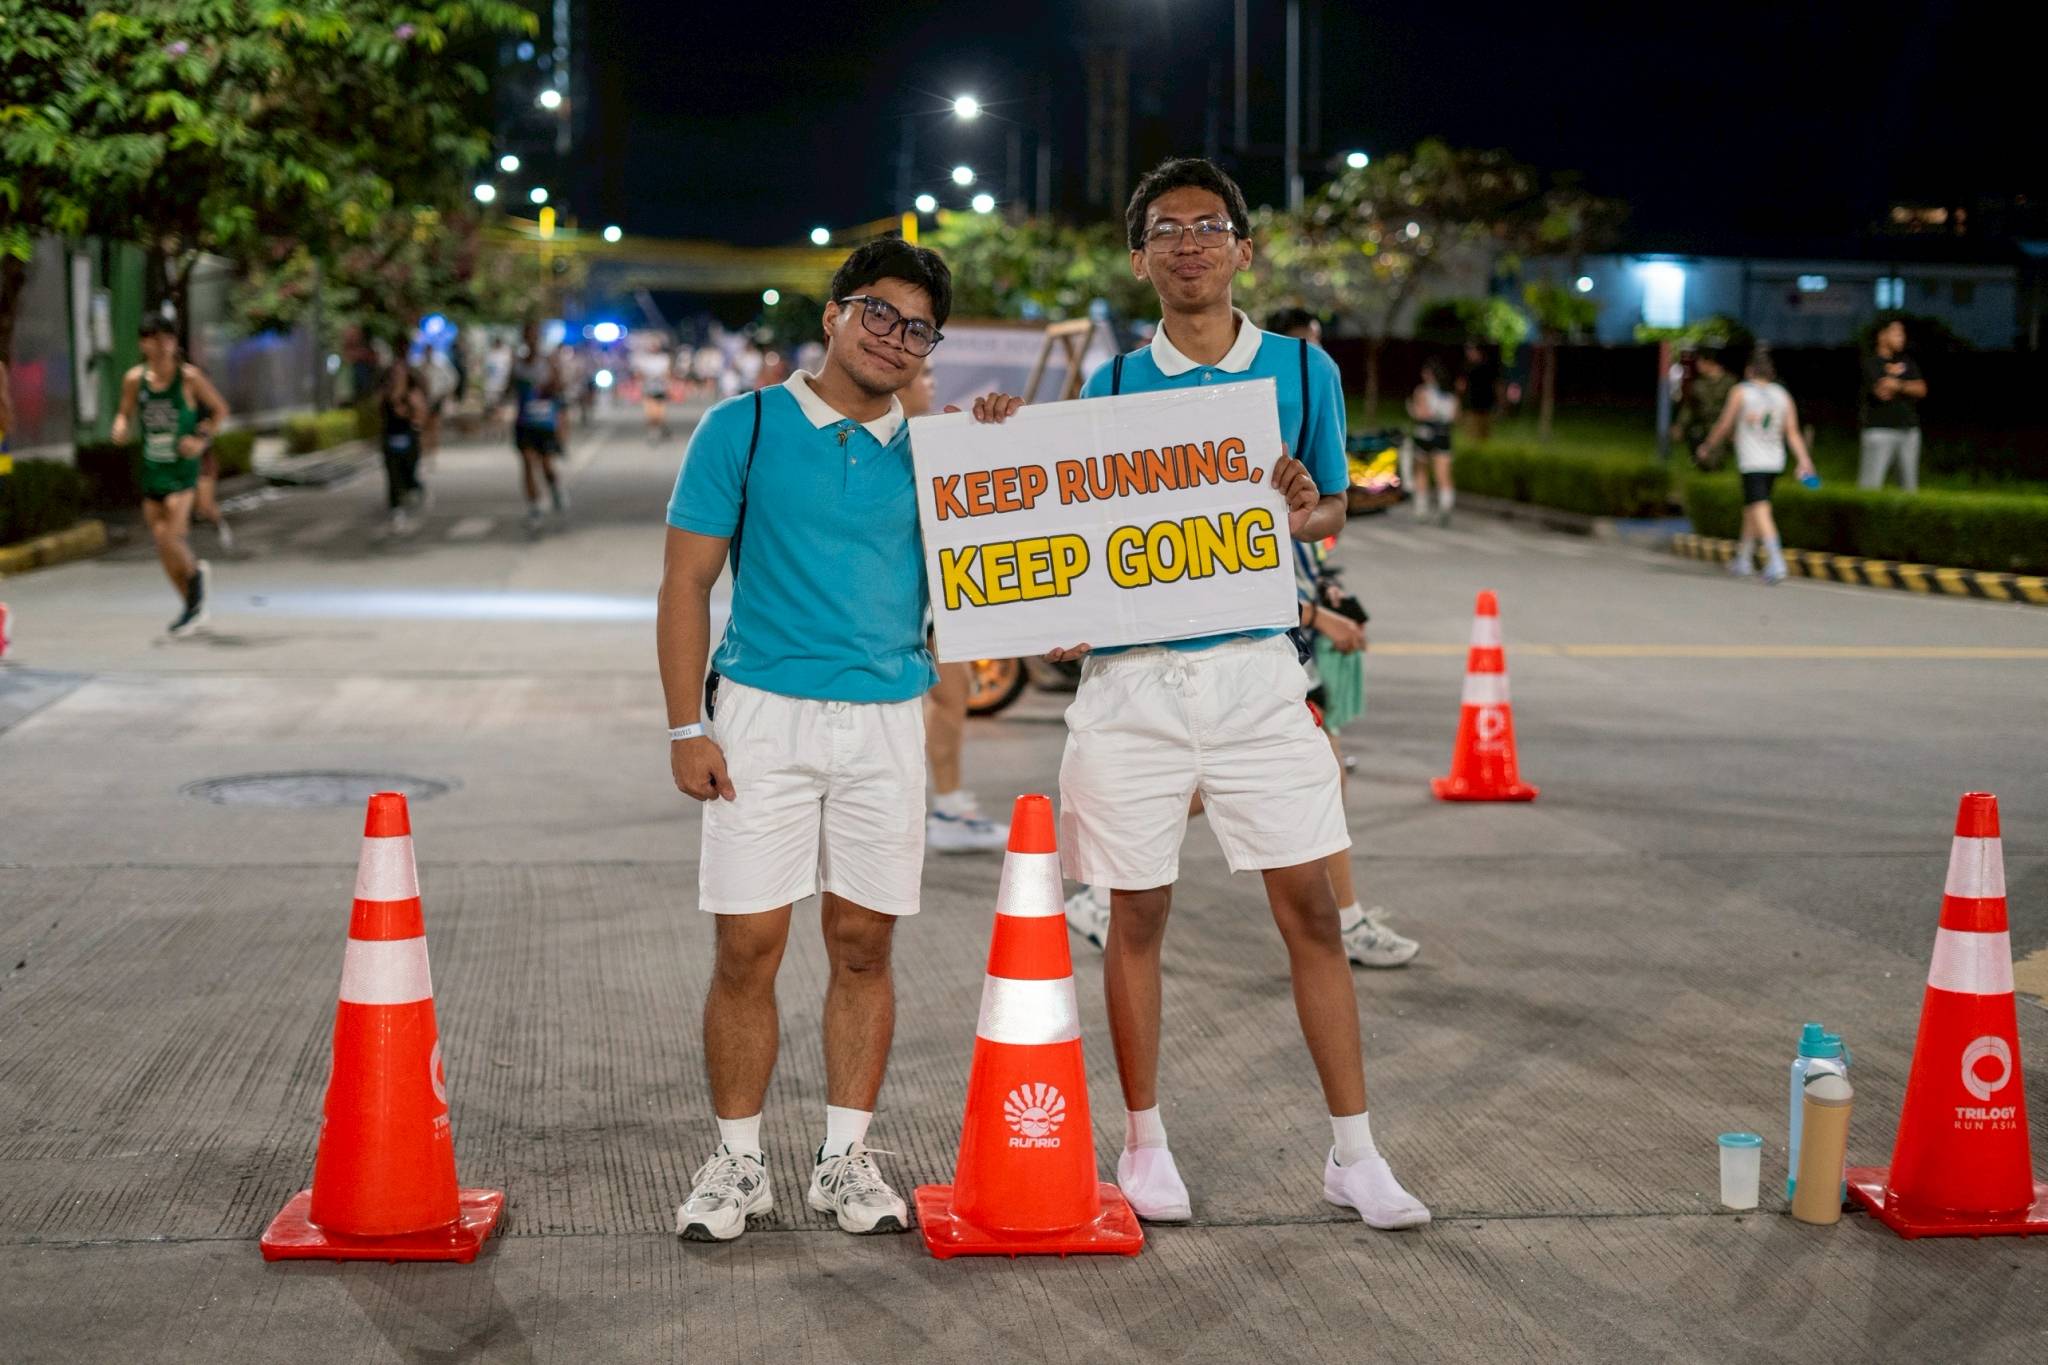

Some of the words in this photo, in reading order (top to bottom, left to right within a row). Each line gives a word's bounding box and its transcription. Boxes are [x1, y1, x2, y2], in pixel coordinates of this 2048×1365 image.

[933, 464, 1048, 520] KEEP
[1056, 437, 1264, 505] RUNNING,
[938, 534, 1090, 610] KEEP
[1106, 507, 1280, 589] GOING
[1954, 1107, 2015, 1120] TRILOGY
[1954, 1120, 1983, 1130] RUN
[1991, 1120, 2016, 1130] ASIA
[1009, 1137, 1060, 1149] RUNRIO
